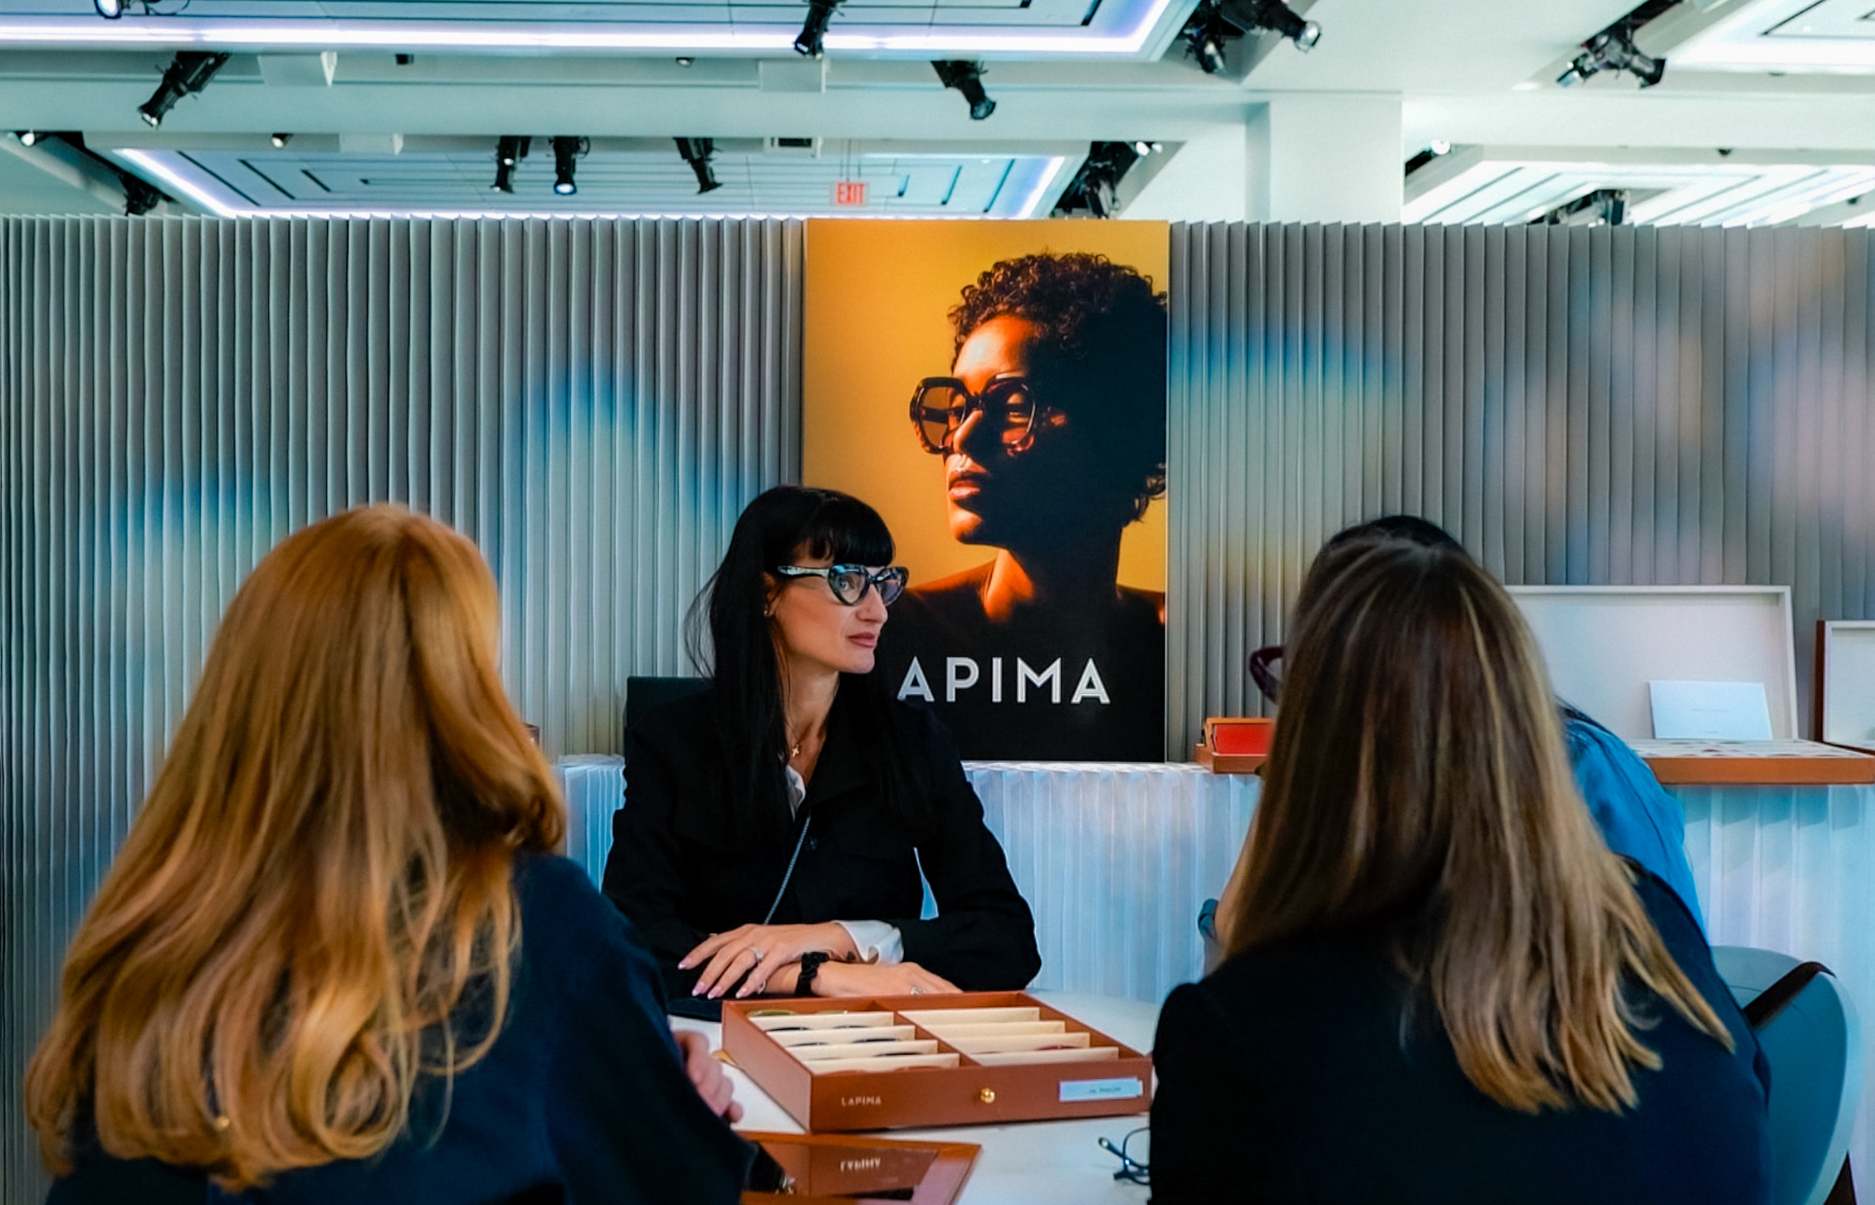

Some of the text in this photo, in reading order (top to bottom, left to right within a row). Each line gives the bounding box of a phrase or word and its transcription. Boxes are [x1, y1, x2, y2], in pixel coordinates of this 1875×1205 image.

[837, 183, 864, 204] EXIT
[897, 655, 1111, 704] APIMA
[841, 1095, 882, 1107] LAPIMA
